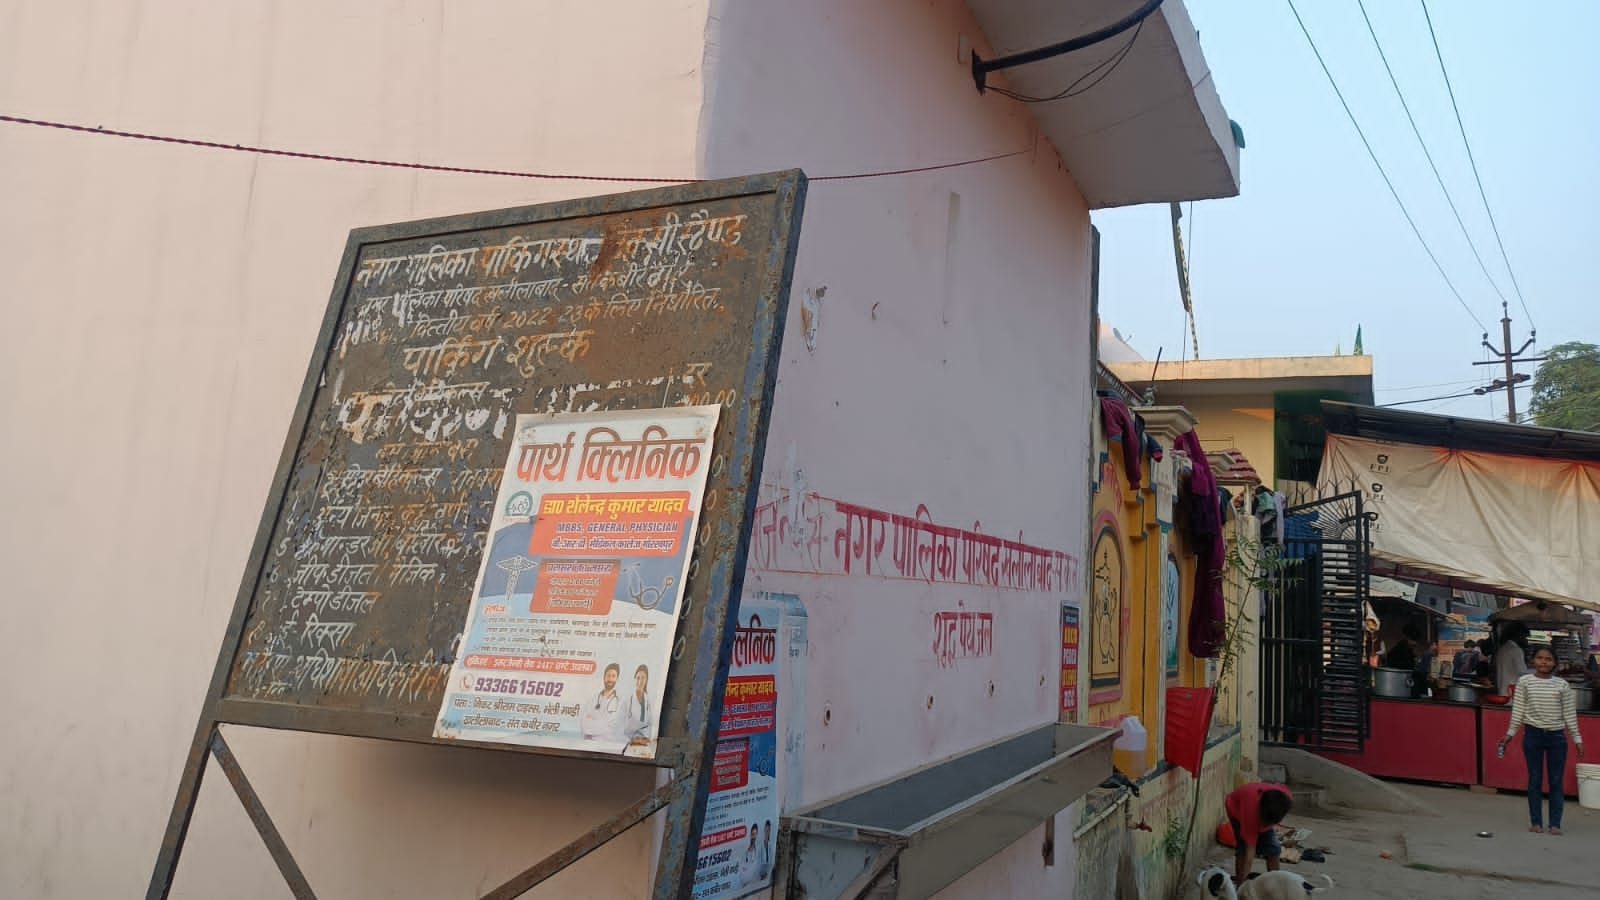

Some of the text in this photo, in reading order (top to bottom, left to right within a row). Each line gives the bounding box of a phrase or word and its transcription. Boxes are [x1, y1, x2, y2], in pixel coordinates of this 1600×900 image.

[517, 432, 576, 483] पार्थ
[577, 425, 705, 484] क्लिनिक
[608, 498, 647, 520] कुमार
[648, 497, 687, 516] यादव
[588, 522, 626, 533] GENERAL
[630, 521, 679, 533] PHYSICIAN
[835, 502, 890, 576] नगर
[891, 504, 962, 584] पालिका
[962, 520, 1001, 587] परिषद
[474, 677, 564, 697] 9336615602
